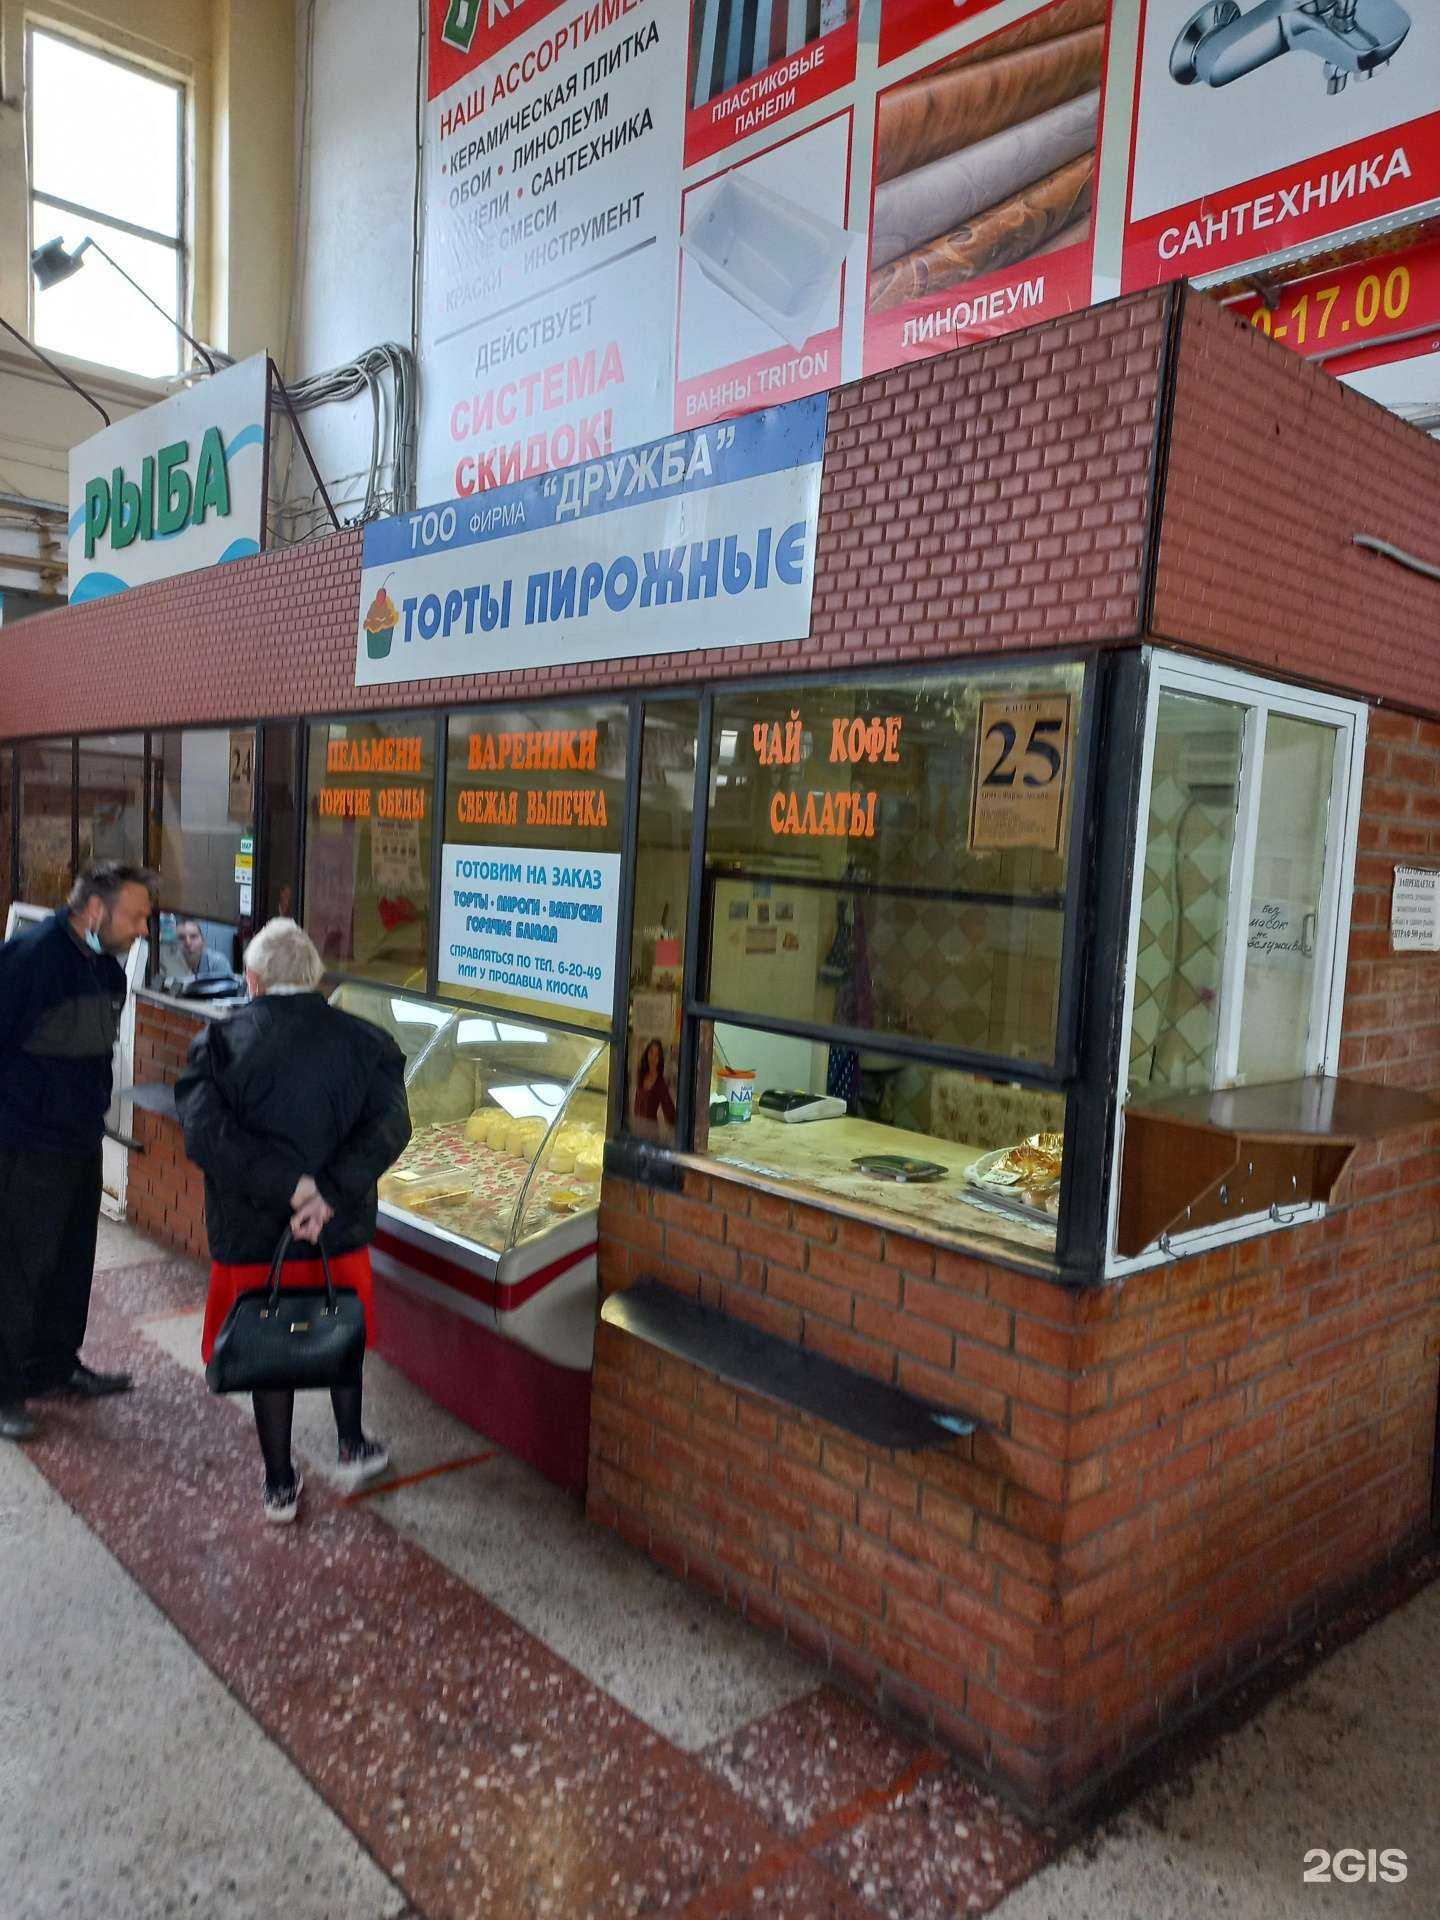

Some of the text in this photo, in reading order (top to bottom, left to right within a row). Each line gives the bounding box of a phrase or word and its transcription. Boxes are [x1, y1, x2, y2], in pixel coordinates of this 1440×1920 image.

[450, 20, 660, 175] КЕРАМИЧЕСКАЯ ПЛИТКА
[711, 45, 825, 122] ПЛАСТИКОВЫЕ
[735, 87, 796, 135] ПАНЕЛИ
[440, 86, 485, 141] НАШ
[449, 93, 609, 209] ОБОИ ЛИНОЛЕУМ
[531, 107, 653, 197] САНТЕХНИКА
[500, 200, 557, 250] СМЕСИ
[1158, 147, 1413, 260] САНТЕХНИКА
[523, 192, 644, 274] ИНСТРУМЕНТ
[475, 296, 598, 378] ДЕЙСТВУЕТ
[902, 276, 1045, 348] ЛИНОЛЕУМ
[450, 342, 625, 441] СИСТЕМА
[686, 350, 829, 417] ВАННЫ TRITON
[454, 408, 614, 498] СКИДОК!
[84, 426, 231, 560] РЫБА
[409, 511, 456, 549] ТОО
[468, 506, 527, 535] ФИРМА
[402, 519, 806, 643] ТОРТЫ ПИРОЖНЫЕ
[327, 735, 422, 773] ПЕЛЬМЕНИ
[467, 728, 599, 771] ВАРЕНИКИ
[752, 707, 903, 765] ЧАЙ КОФЕ
[982, 720, 1063, 788] 25
[231, 749, 251, 783] 24
[319, 786, 425, 820] ГОРЯЧИЕ ОБЕДЫ
[457, 789, 608, 827] СВЕЖАЯ ВЫПЕЧКА
[769, 790, 877, 837] САЛАТЫ
[455, 860, 602, 890] ГОТОВИМ НА ЗАКАЗ
[453, 890, 603, 923] ТОРТЫ ПИРОГИ ЗАКУСКИ
[466, 915, 558, 943] ГОРЯЧИЕ БЛЮДА
[450, 943, 602, 980] СПРАВЛЯТЬСЯ ПО ТЕЛ. 6-20-49
[458, 963, 589, 999] ИЛИ У ПРОДАВЦА КИОСКА
[730, 1090, 753, 1102] NA
